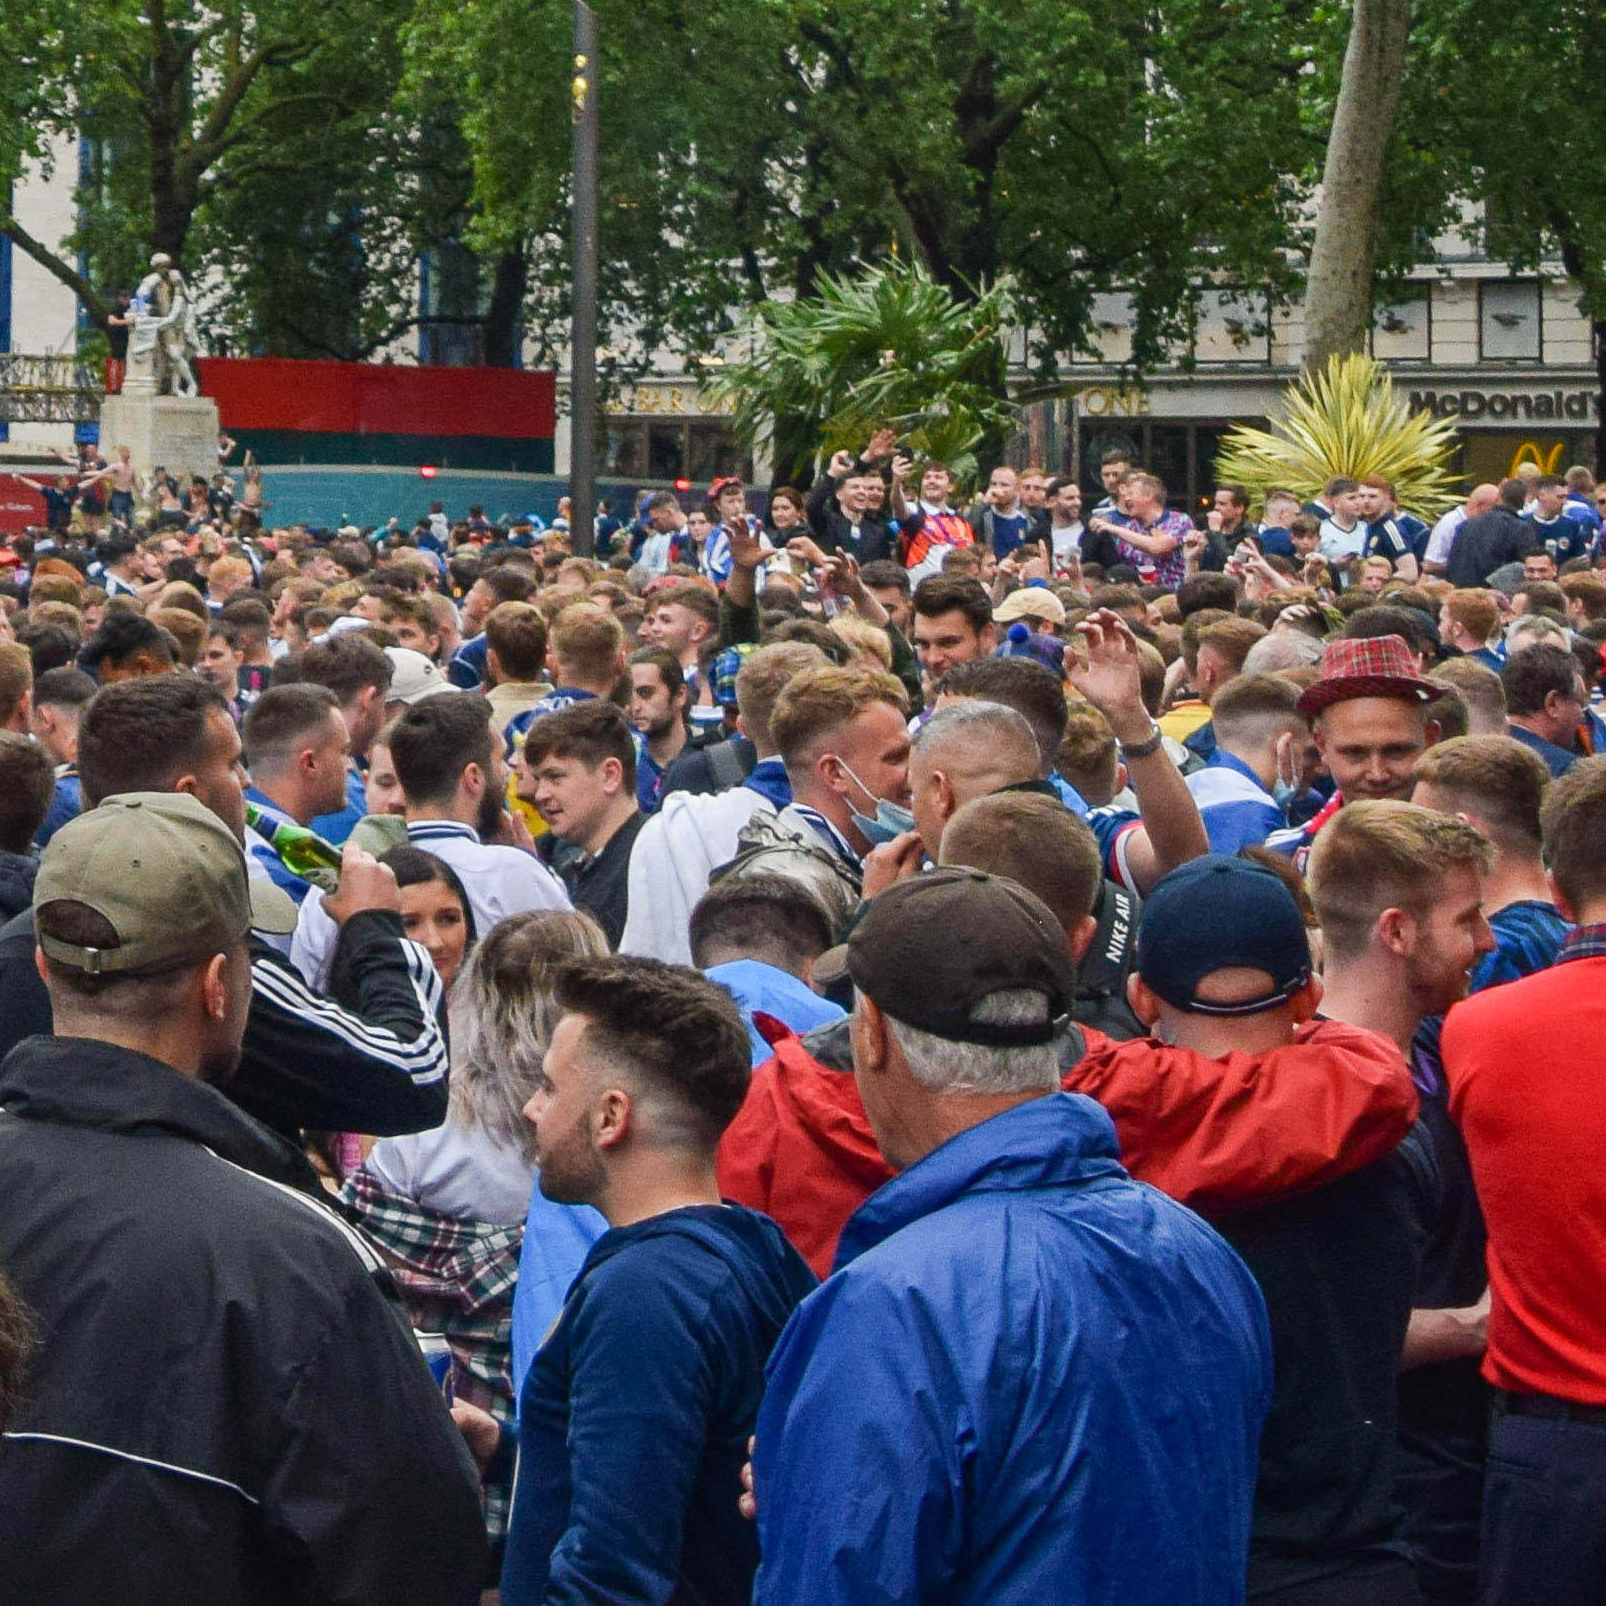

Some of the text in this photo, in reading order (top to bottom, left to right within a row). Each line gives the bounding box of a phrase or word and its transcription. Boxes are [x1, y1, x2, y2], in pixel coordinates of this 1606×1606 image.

[1409, 390, 1599, 420] McDonald'
[1105, 893, 1130, 964] NIKE AIR
